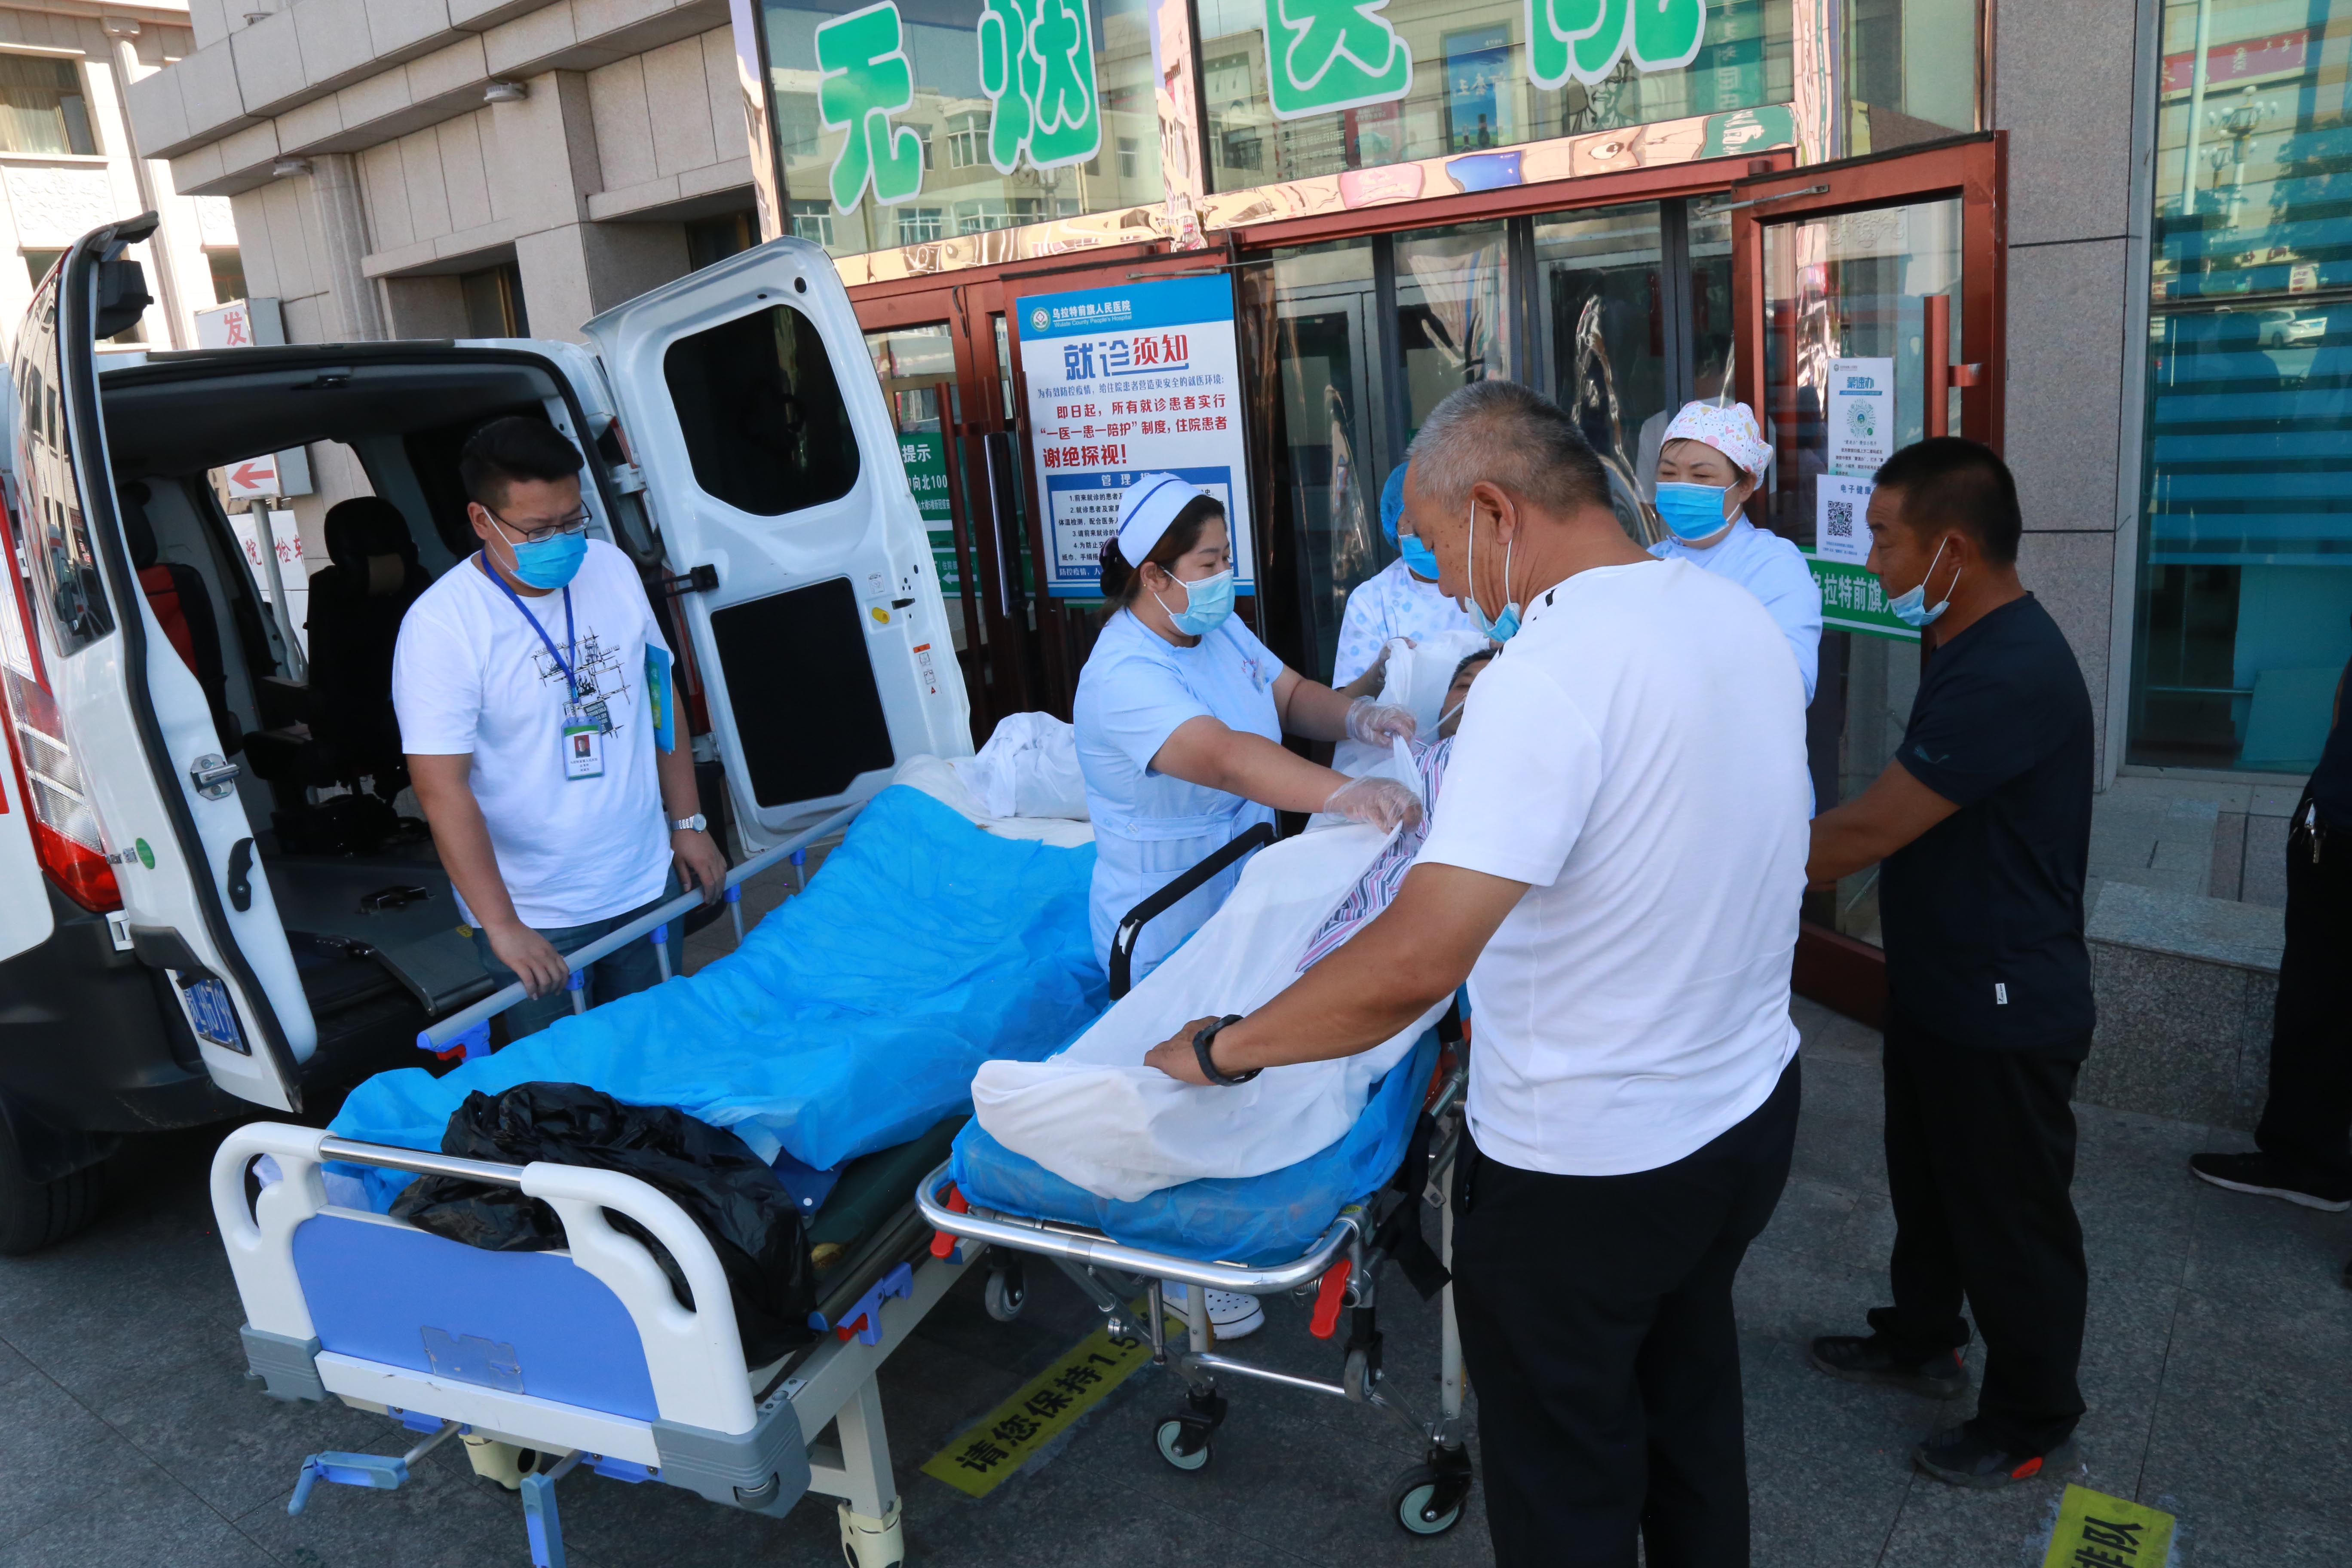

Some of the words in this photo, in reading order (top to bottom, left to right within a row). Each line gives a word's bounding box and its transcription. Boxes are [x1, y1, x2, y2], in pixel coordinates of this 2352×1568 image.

[1053, 300, 1131, 319] 乌拉特前旗人民医院
[224, 311, 247, 346] 发
[1064, 334, 1189, 380] 就诊须知
[1847, 376, 1874, 389] 蒙速办
[1057, 393, 1225, 419] 即日起，所有就诊患者实行
[902, 444, 931, 463] 提示
[1043, 443, 1127, 468] 谢绝探视！
[908, 474, 948, 491] 向北100
